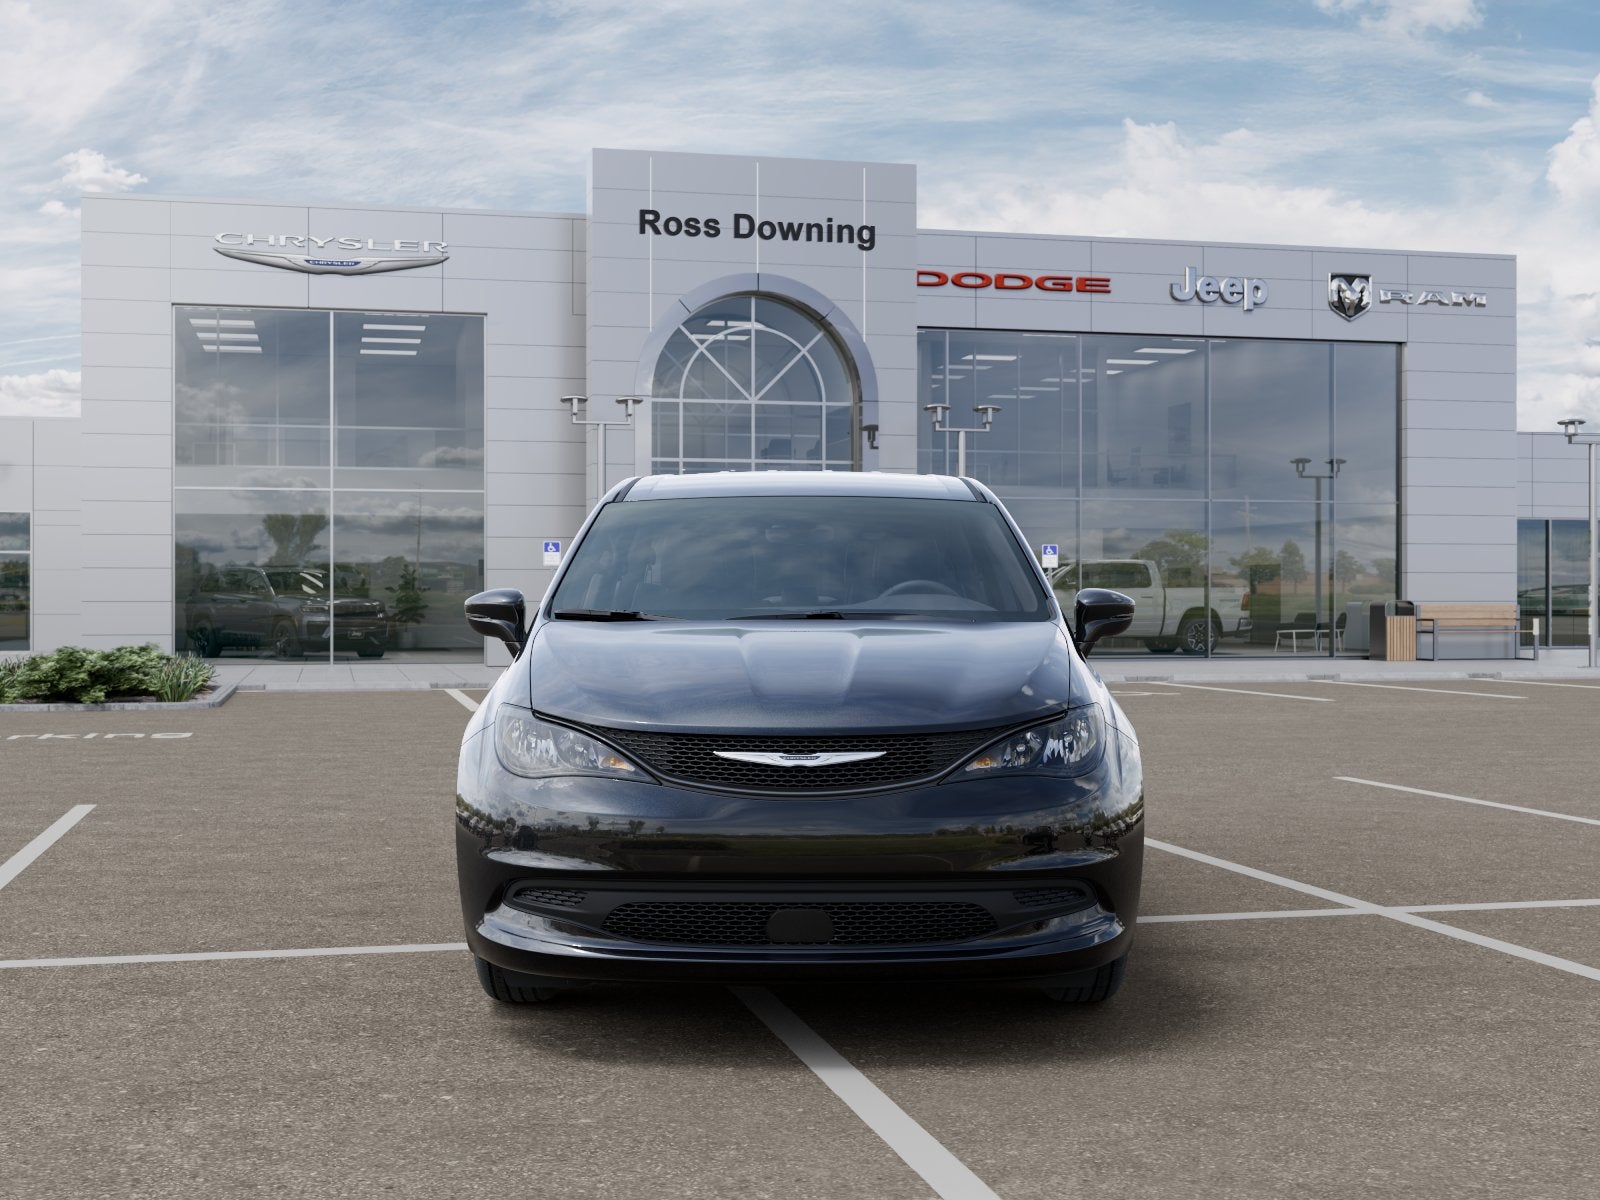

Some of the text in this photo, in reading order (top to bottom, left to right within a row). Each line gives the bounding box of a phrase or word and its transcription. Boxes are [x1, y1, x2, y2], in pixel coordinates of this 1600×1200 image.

[639, 209, 876, 251] Ross Downing
[214, 232, 449, 254] CHRYSLER
[916, 270, 1112, 294] DODGE
[1169, 266, 1270, 312] Jeep
[1378, 288, 1488, 308] RAM
